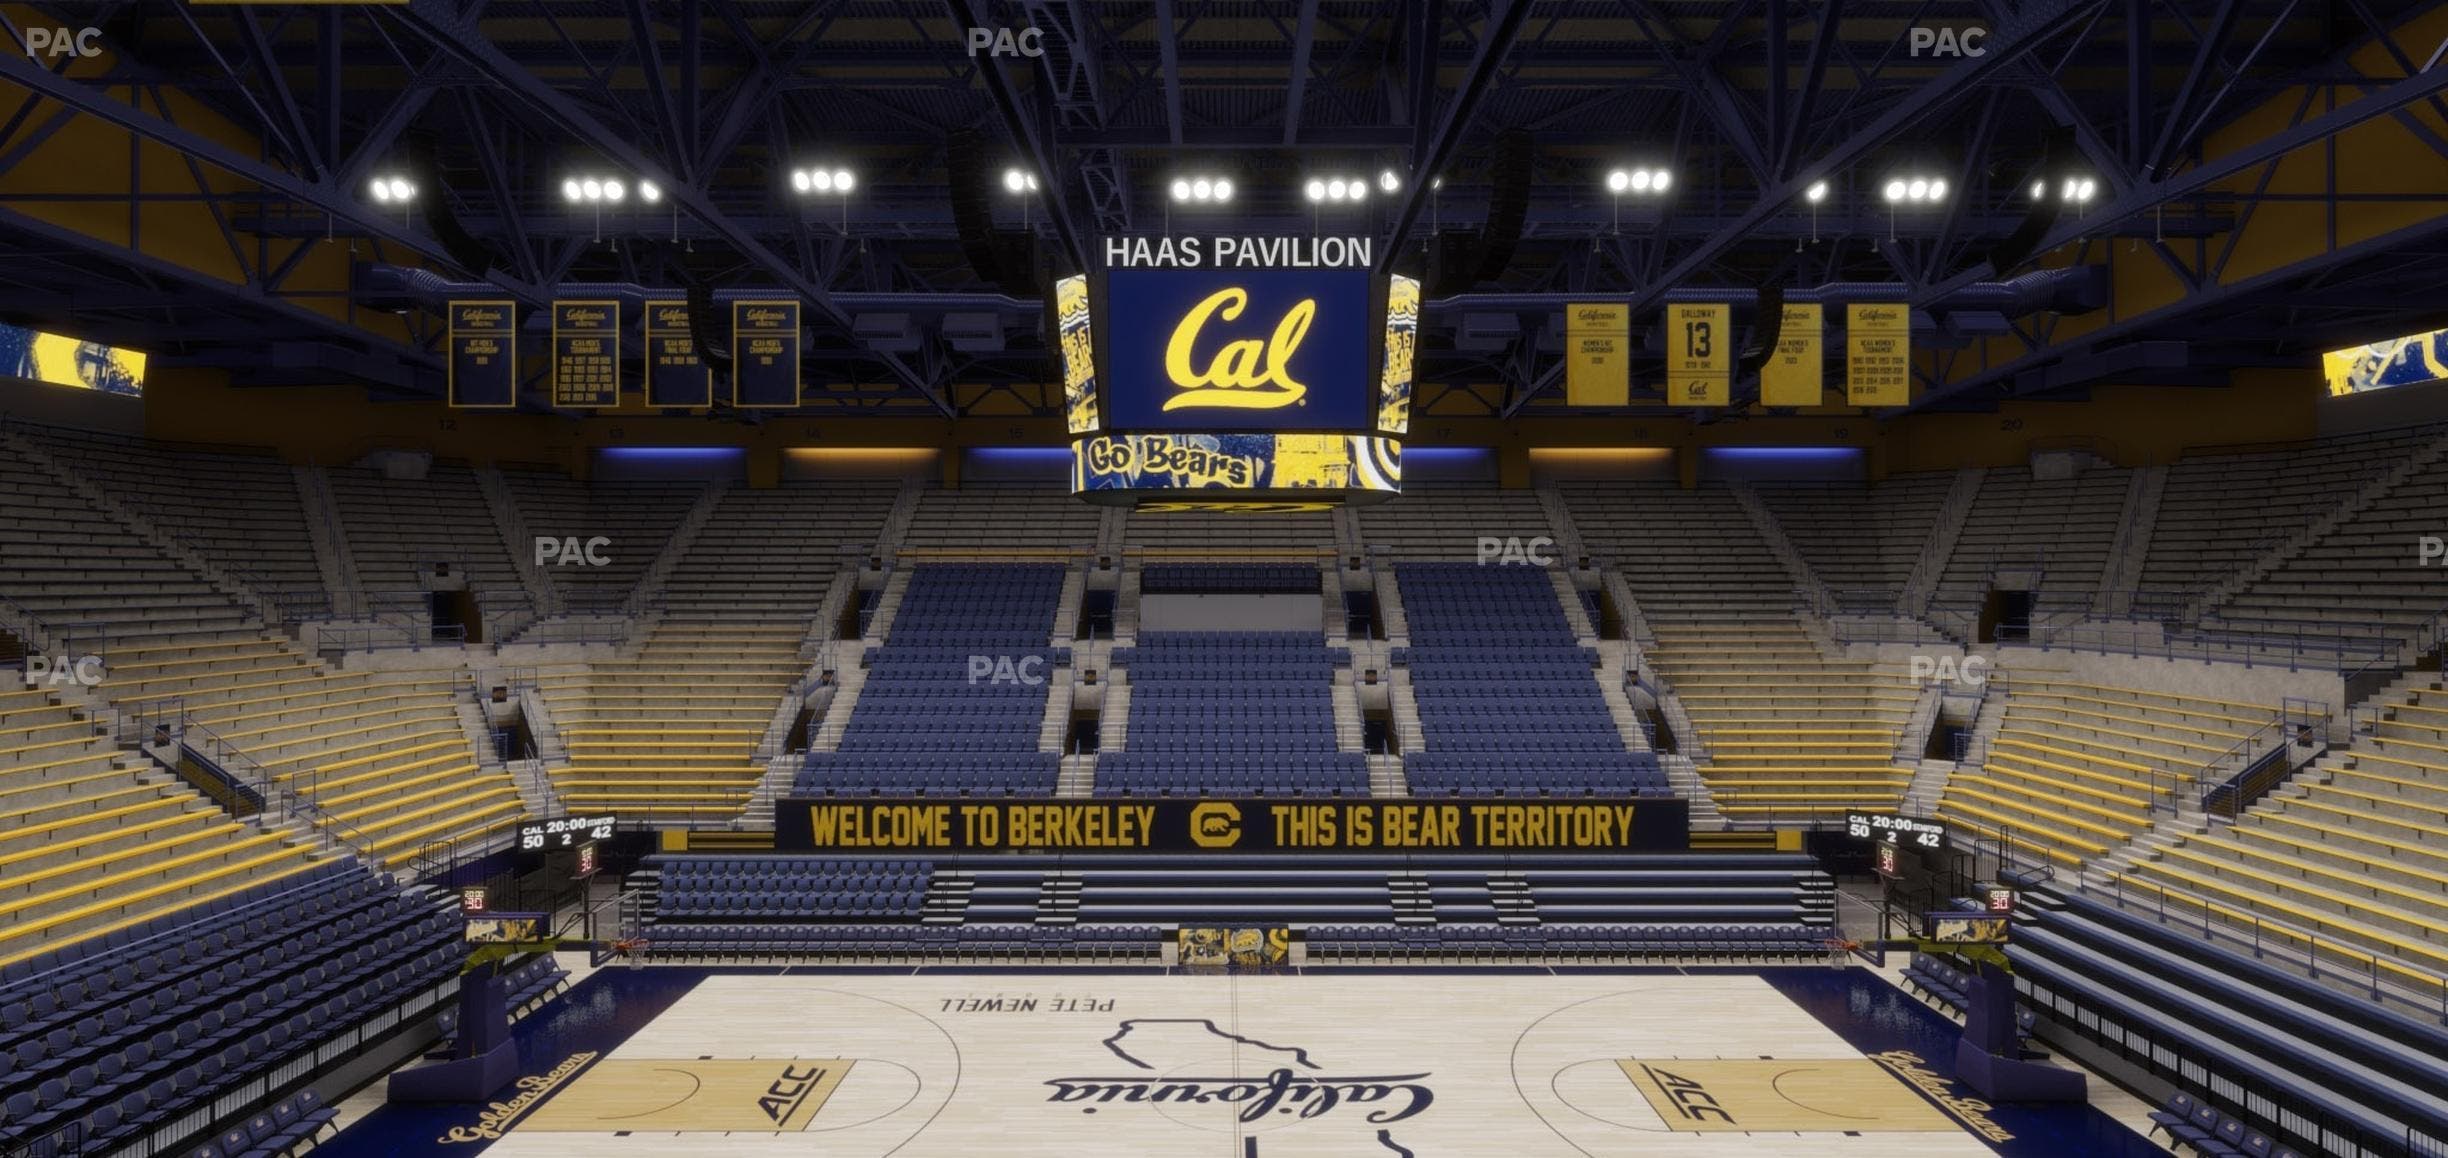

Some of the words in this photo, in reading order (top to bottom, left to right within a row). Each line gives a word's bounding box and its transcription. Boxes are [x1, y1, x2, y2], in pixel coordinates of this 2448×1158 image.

[1106, 237, 1201, 267] HAAS
[1215, 237, 1371, 267] PAVILION
[1681, 309, 1716, 320] GALLOWAY
[1685, 322, 1712, 358] 13
[1162, 287, 1316, 411] Cal
[2000, 418, 2024, 432] 20
[1090, 437, 1132, 471] Go
[1144, 436, 1248, 484] Bears
[547, 818, 586, 834] 20:00
[811, 806, 951, 846] WELCOME
[961, 806, 999, 846] TO
[1009, 806, 1155, 846] BERKELEY
[1272, 806, 1336, 846] THIS
[1347, 806, 1373, 846] IS
[1383, 806, 1460, 846] BEAR
[1472, 806, 1634, 846] TERRITORY
[1849, 815, 1870, 825] CAL
[1872, 815, 1913, 831] 20:00
[522, 827, 544, 836] CAL
[591, 826, 612, 840] 42
[1850, 824, 1870, 837] 50
[1887, 832, 1897, 843] 2
[523, 835, 544, 849] 50
[562, 834, 571, 845] 2
[1917, 833, 1940, 847] 42
[1991, 897, 2009, 910] 30
[941, 998, 1038, 1013] NEWELL
[1049, 998, 1116, 1013] PETE
[437, 1090, 537, 1144] Golden
[516, 1051, 598, 1093] Bears
[757, 1063, 822, 1123] ACC
[1043, 1068, 1434, 1124] California
[1648, 1066, 1738, 1125] ACC
